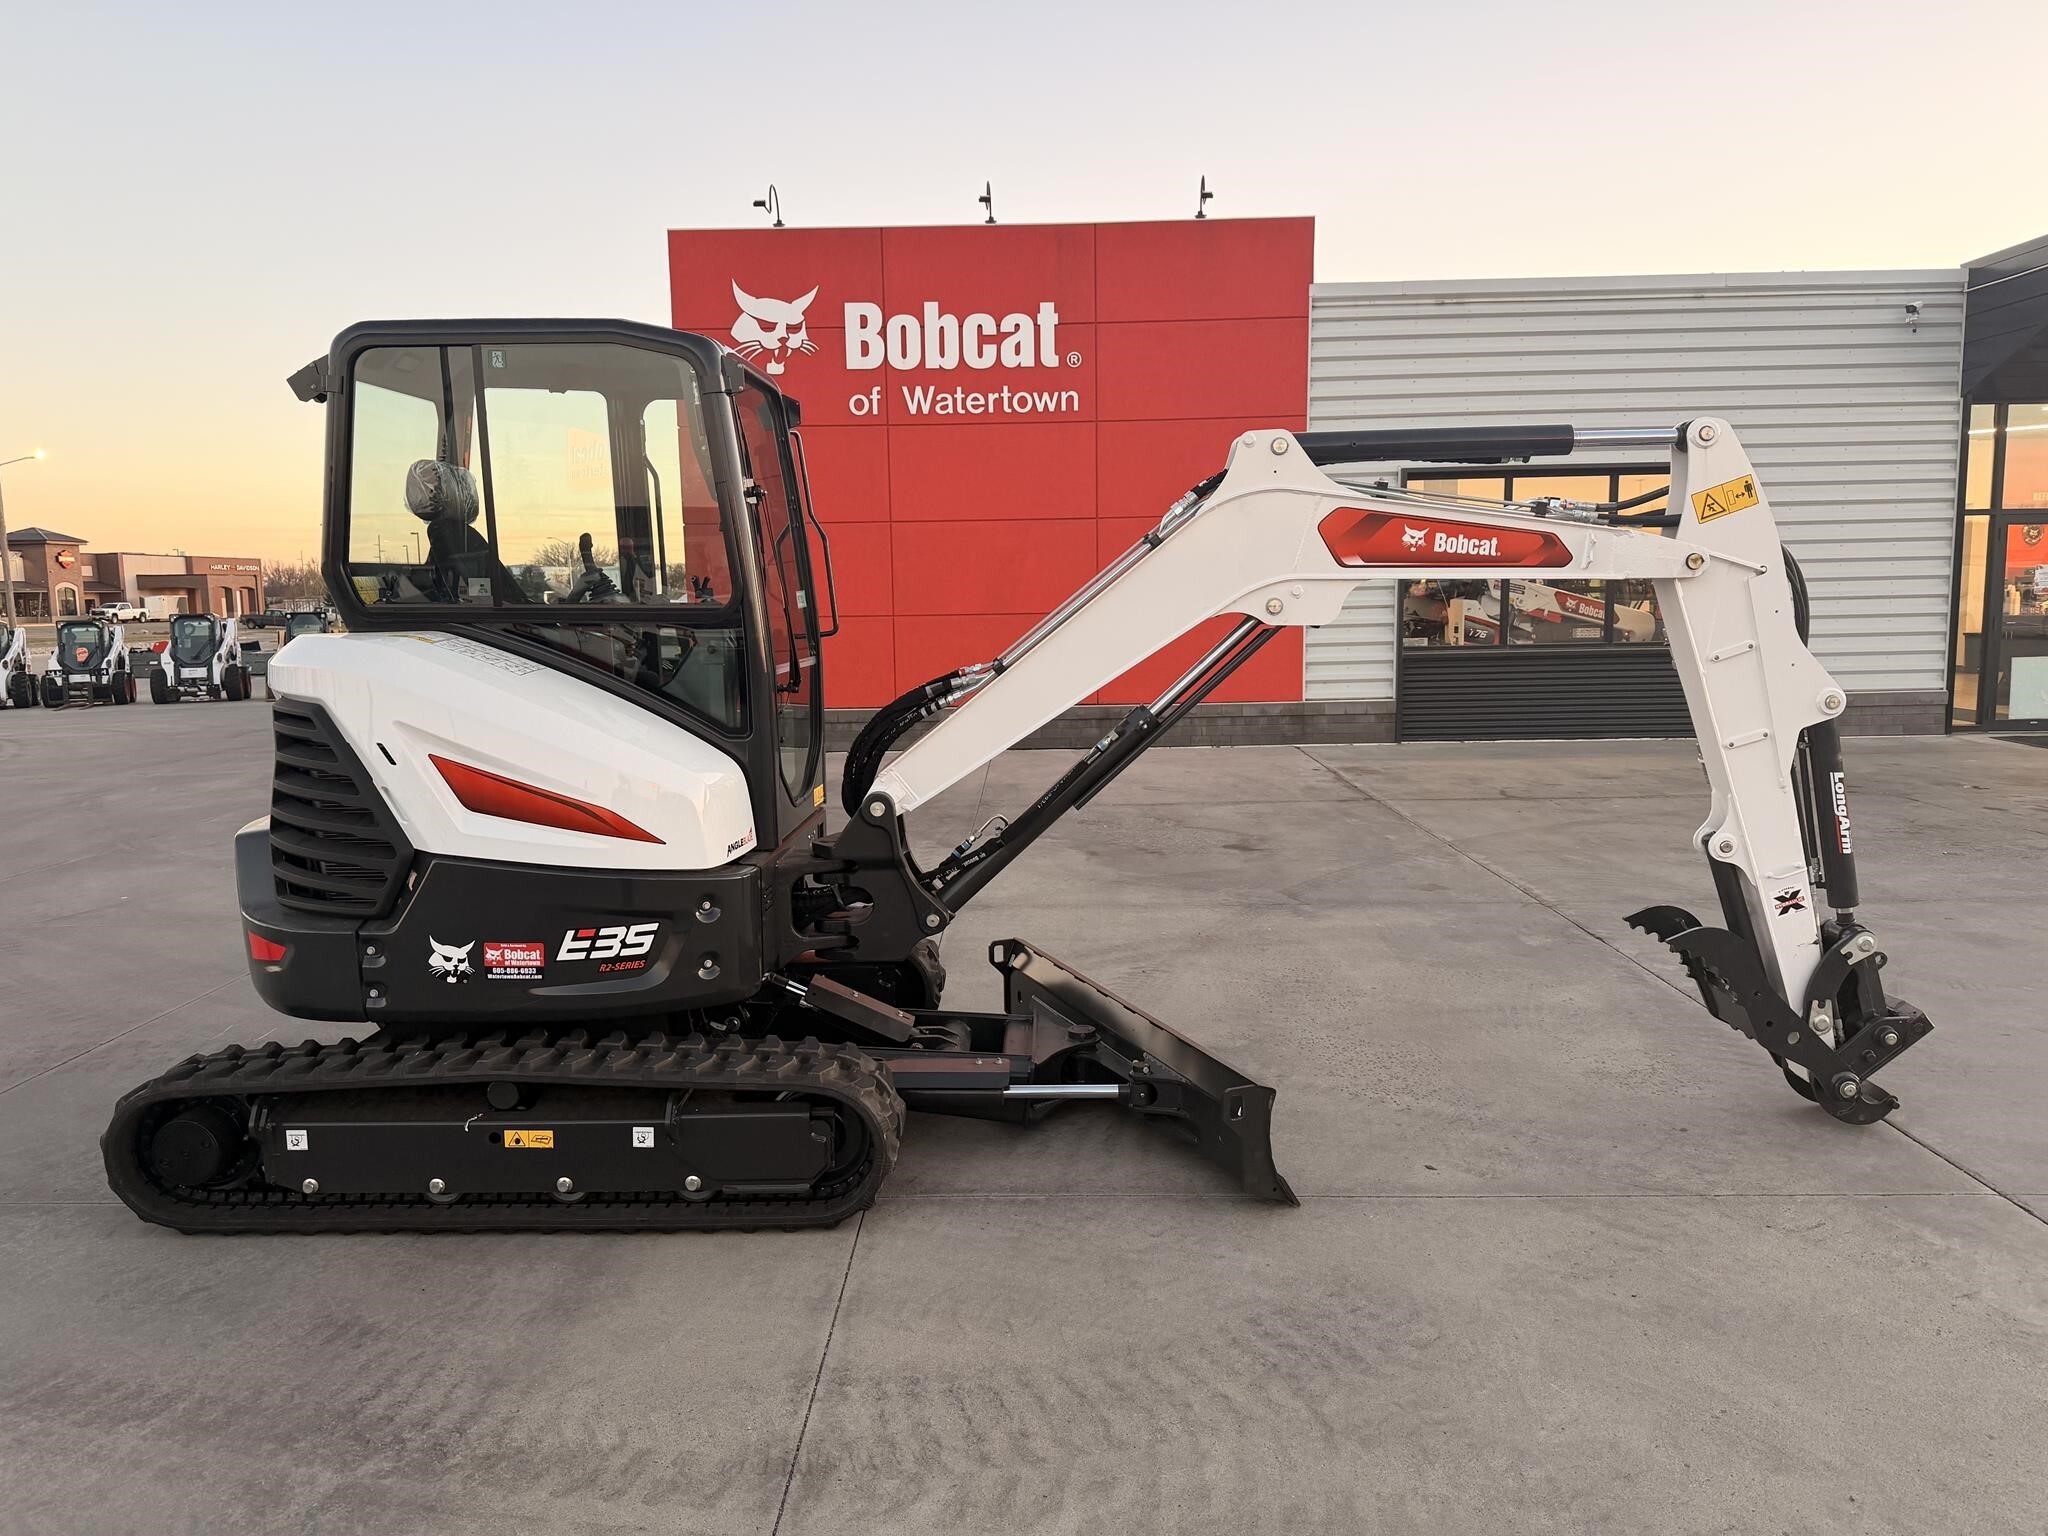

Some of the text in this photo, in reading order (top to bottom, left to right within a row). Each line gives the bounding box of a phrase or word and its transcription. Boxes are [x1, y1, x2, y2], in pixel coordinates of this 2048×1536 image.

[844, 301, 1060, 370] Bobcat
[848, 385, 1080, 416] of Watertown
[1433, 532, 1498, 556] Bobcat
[1830, 771, 1852, 855] LongArm
[504, 948, 540, 960] Bobcat
[556, 922, 660, 961] E35
[600, 960, 646, 972] R2-SERIES
